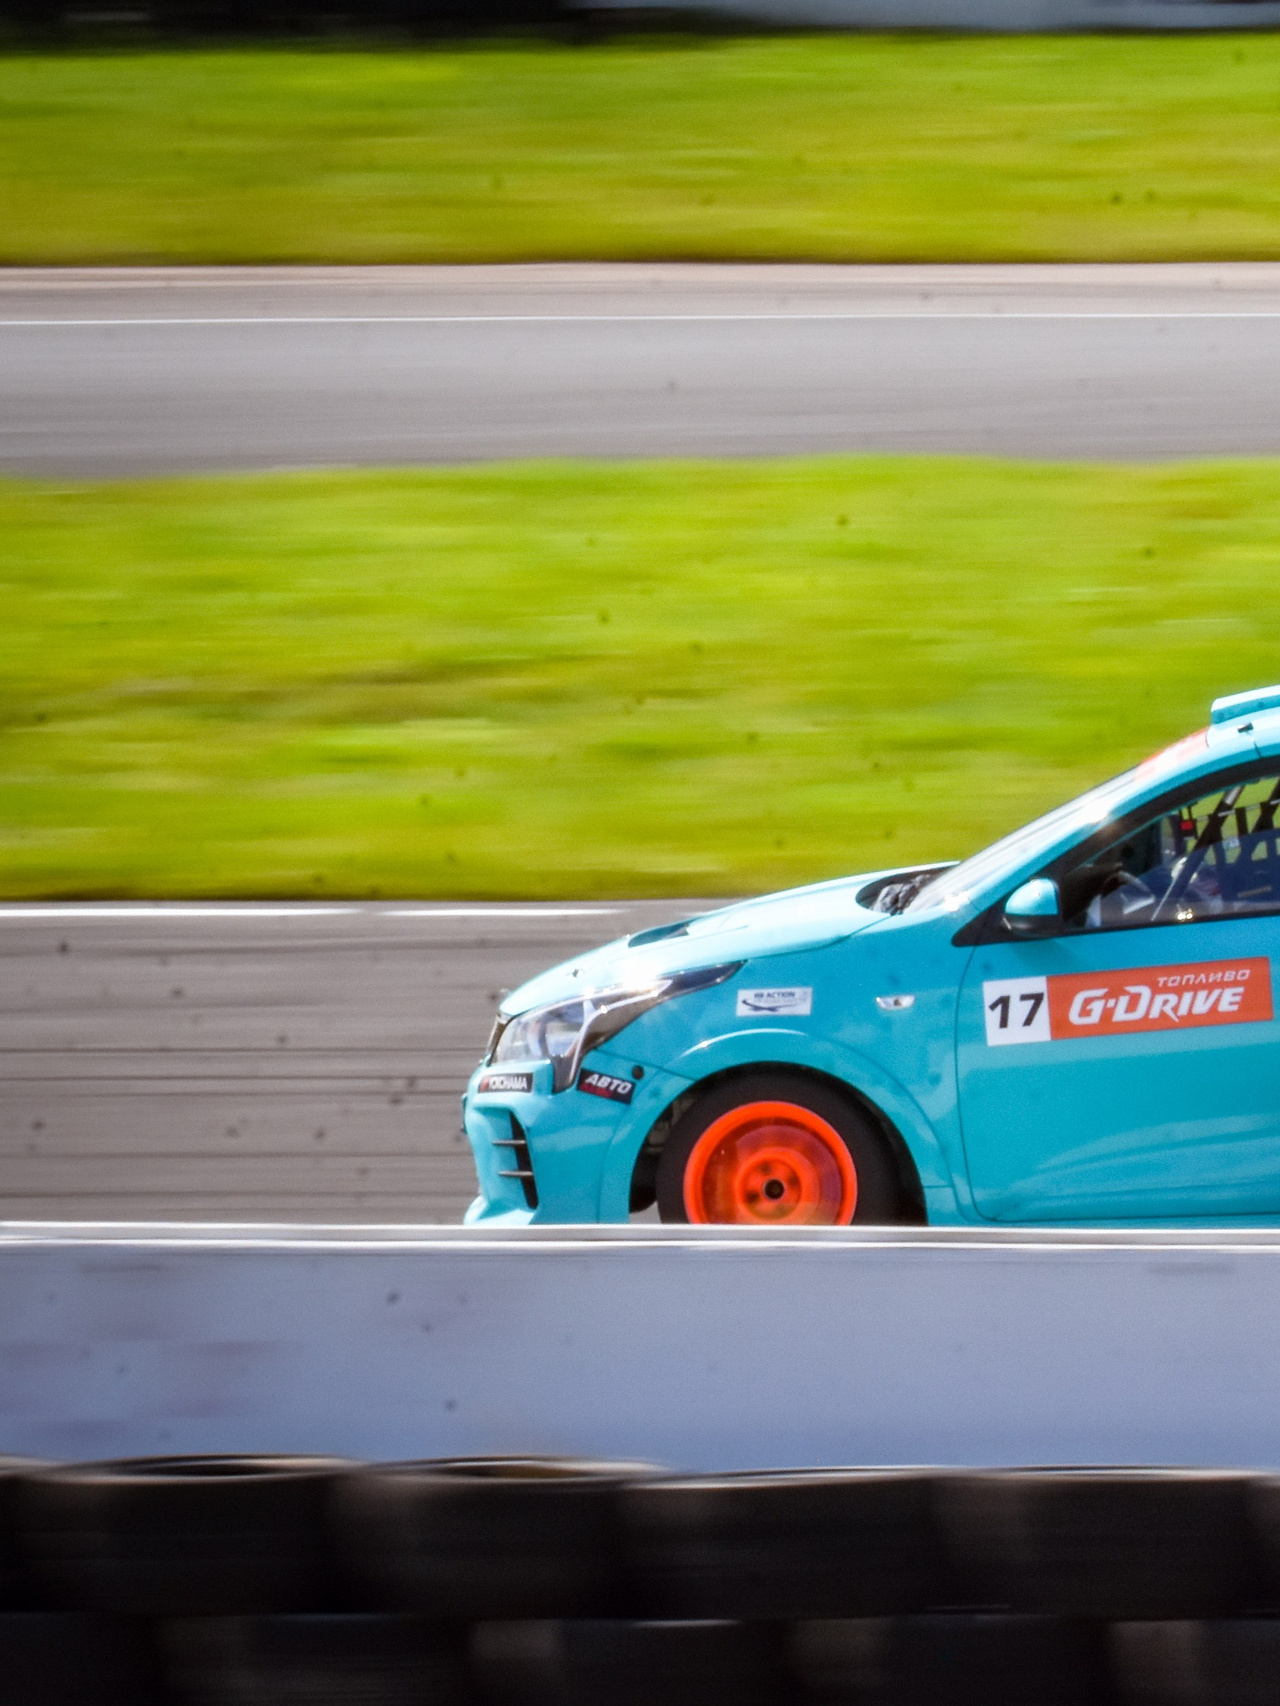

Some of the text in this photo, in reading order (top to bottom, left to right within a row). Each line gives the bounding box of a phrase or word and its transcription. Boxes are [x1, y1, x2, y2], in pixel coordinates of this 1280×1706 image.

[1157, 969, 1251, 988] ТОПЛИВО
[988, 992, 1045, 1029] 17
[584, 1073, 632, 1095] АВТО
